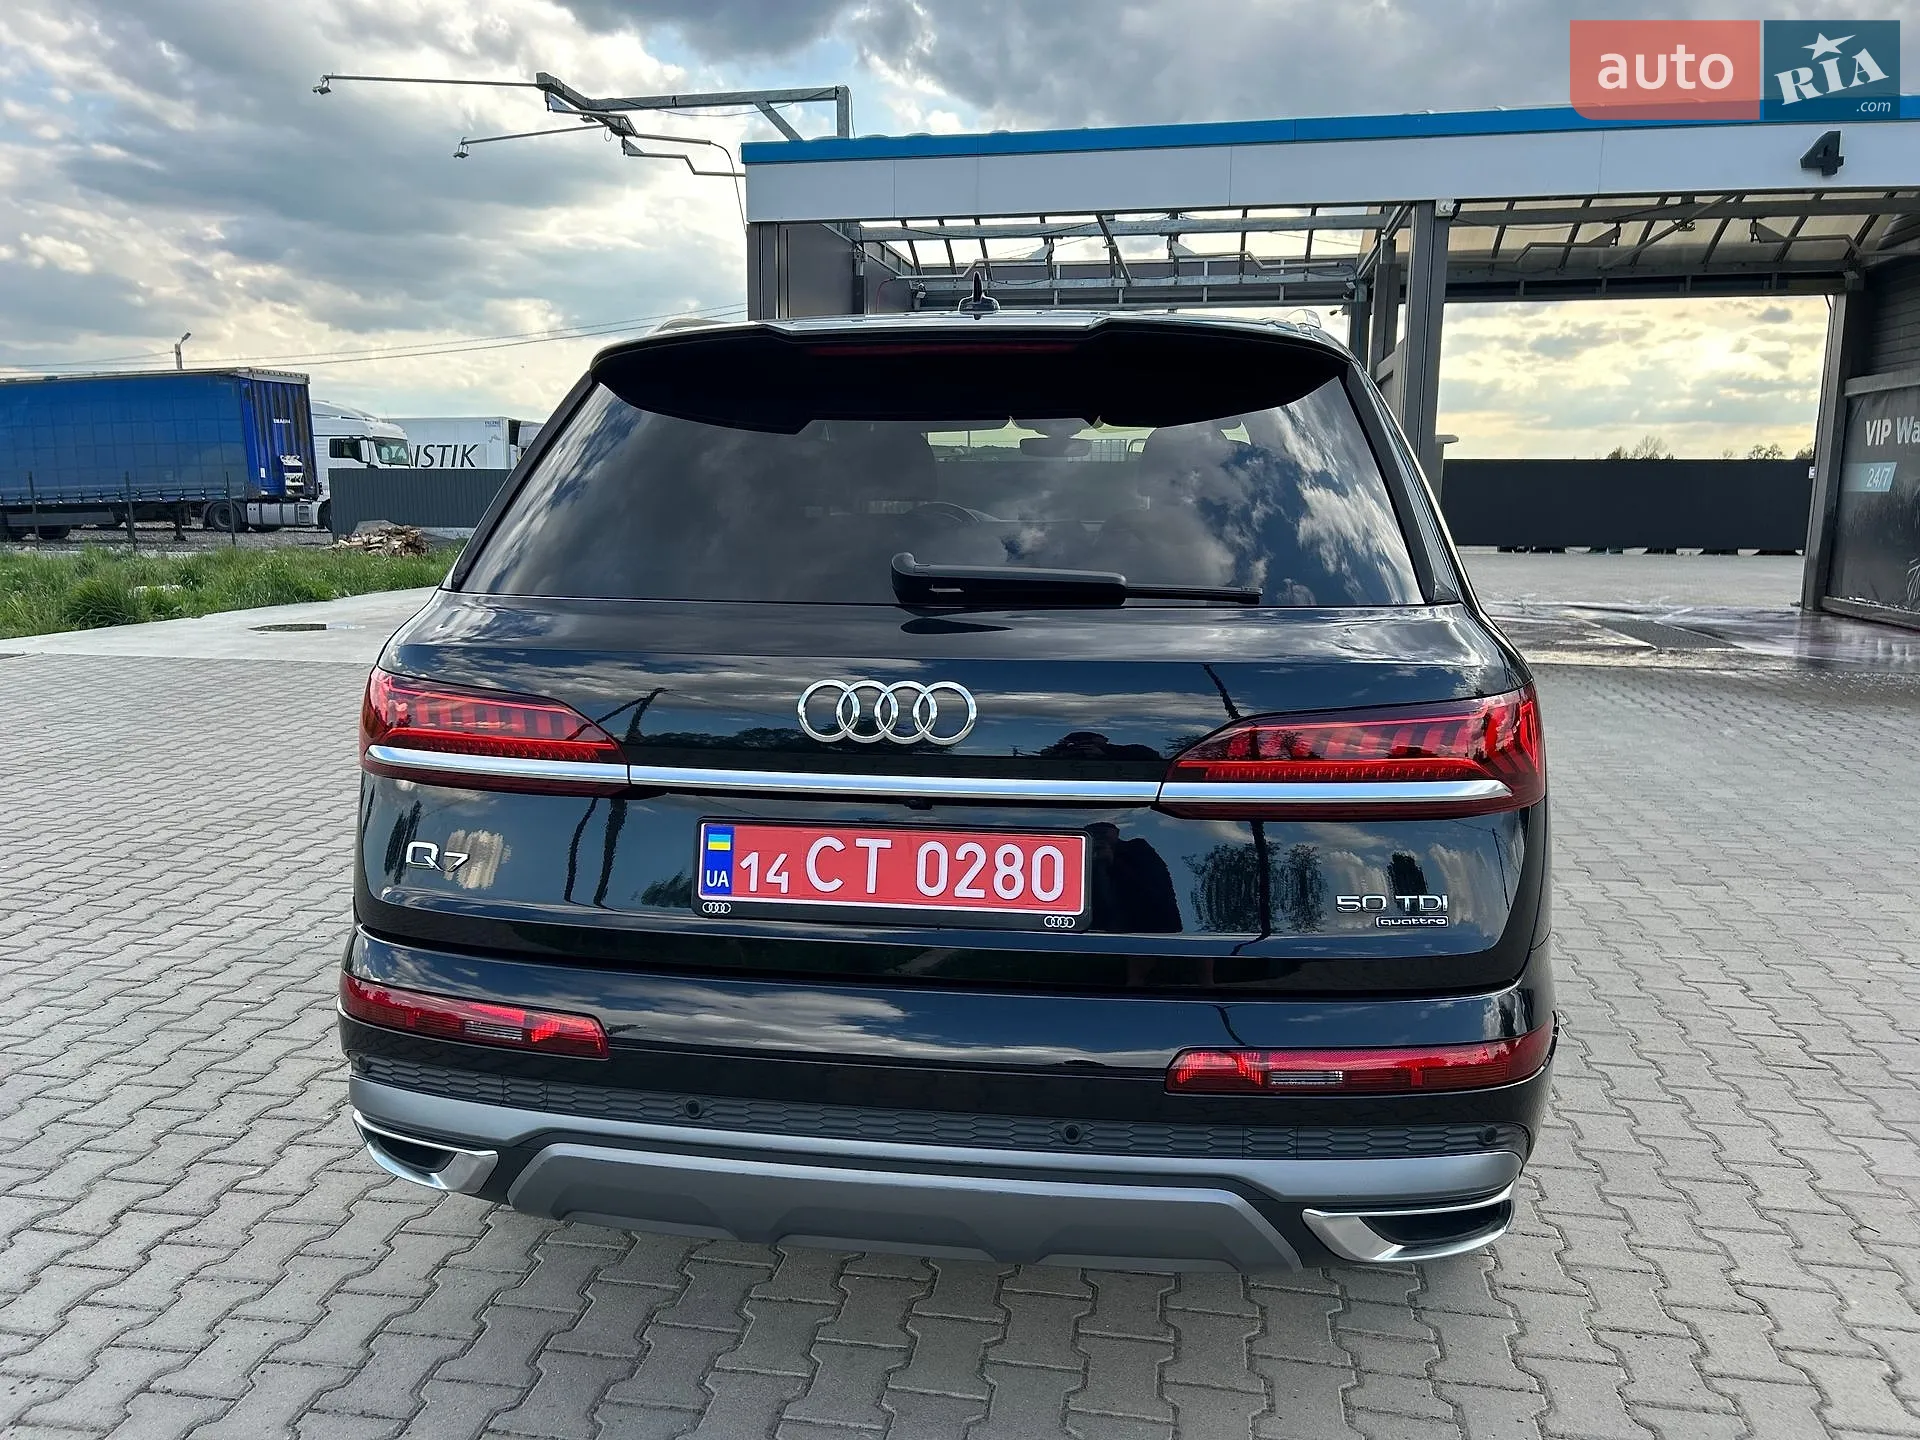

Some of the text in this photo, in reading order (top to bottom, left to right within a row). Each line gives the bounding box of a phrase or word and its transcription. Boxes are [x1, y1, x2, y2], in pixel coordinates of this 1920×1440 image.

[1799, 130, 1844, 176] 4
[1865, 418, 1892, 446] VIP
[1866, 466, 1891, 488] 24/7
[405, 841, 469, 872] Q7
[706, 869, 729, 888] UA
[739, 836, 1064, 903] 14 CT 0280
[1336, 895, 1448, 912] 50 TDI
[1379, 917, 1447, 927] quattro
